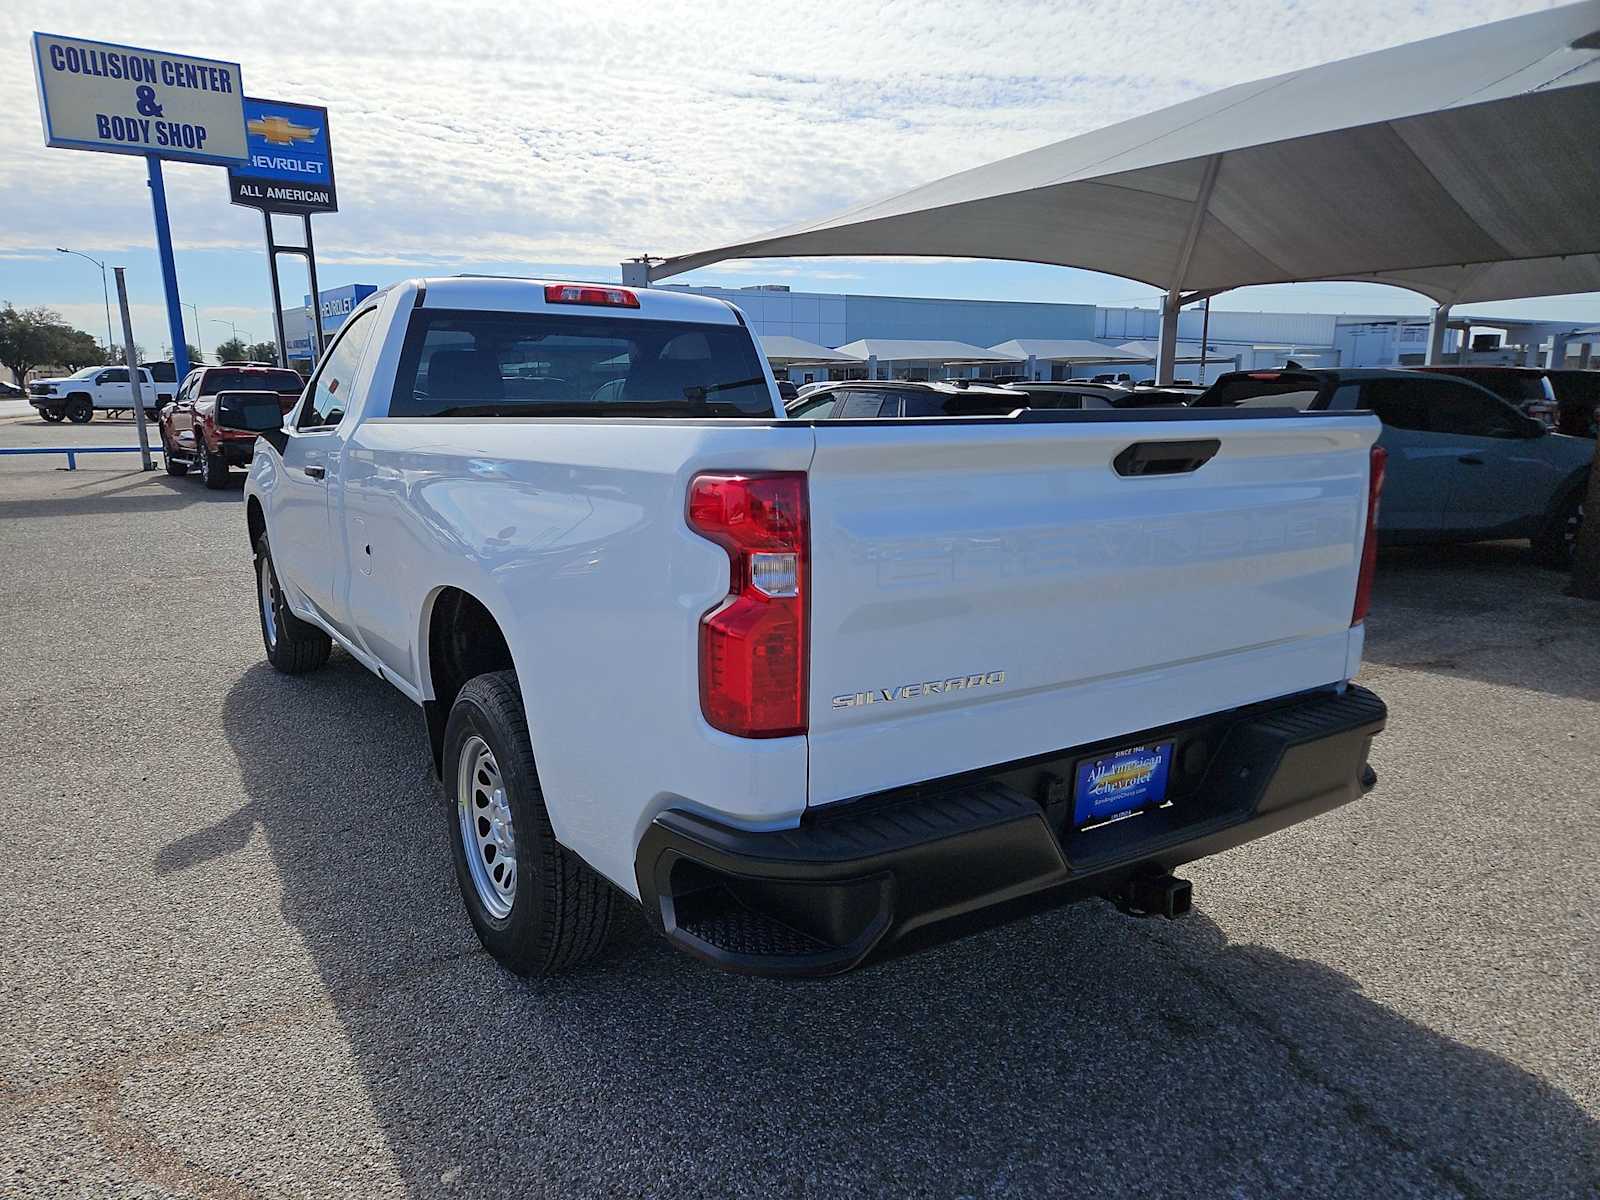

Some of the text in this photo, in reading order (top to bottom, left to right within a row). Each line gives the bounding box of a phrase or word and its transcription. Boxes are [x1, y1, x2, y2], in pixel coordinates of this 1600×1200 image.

[50, 44, 233, 93] COLLISION CENTER
[136, 85, 163, 118] &
[96, 113, 207, 150] BODY SHOP
[247, 154, 324, 174] HEVROLET
[240, 184, 330, 204] ALL AMERICAN
[832, 670, 1007, 711] SILVERADO
[1088, 766, 1105, 782] All
[1095, 773, 1150, 796] Chevrolet
